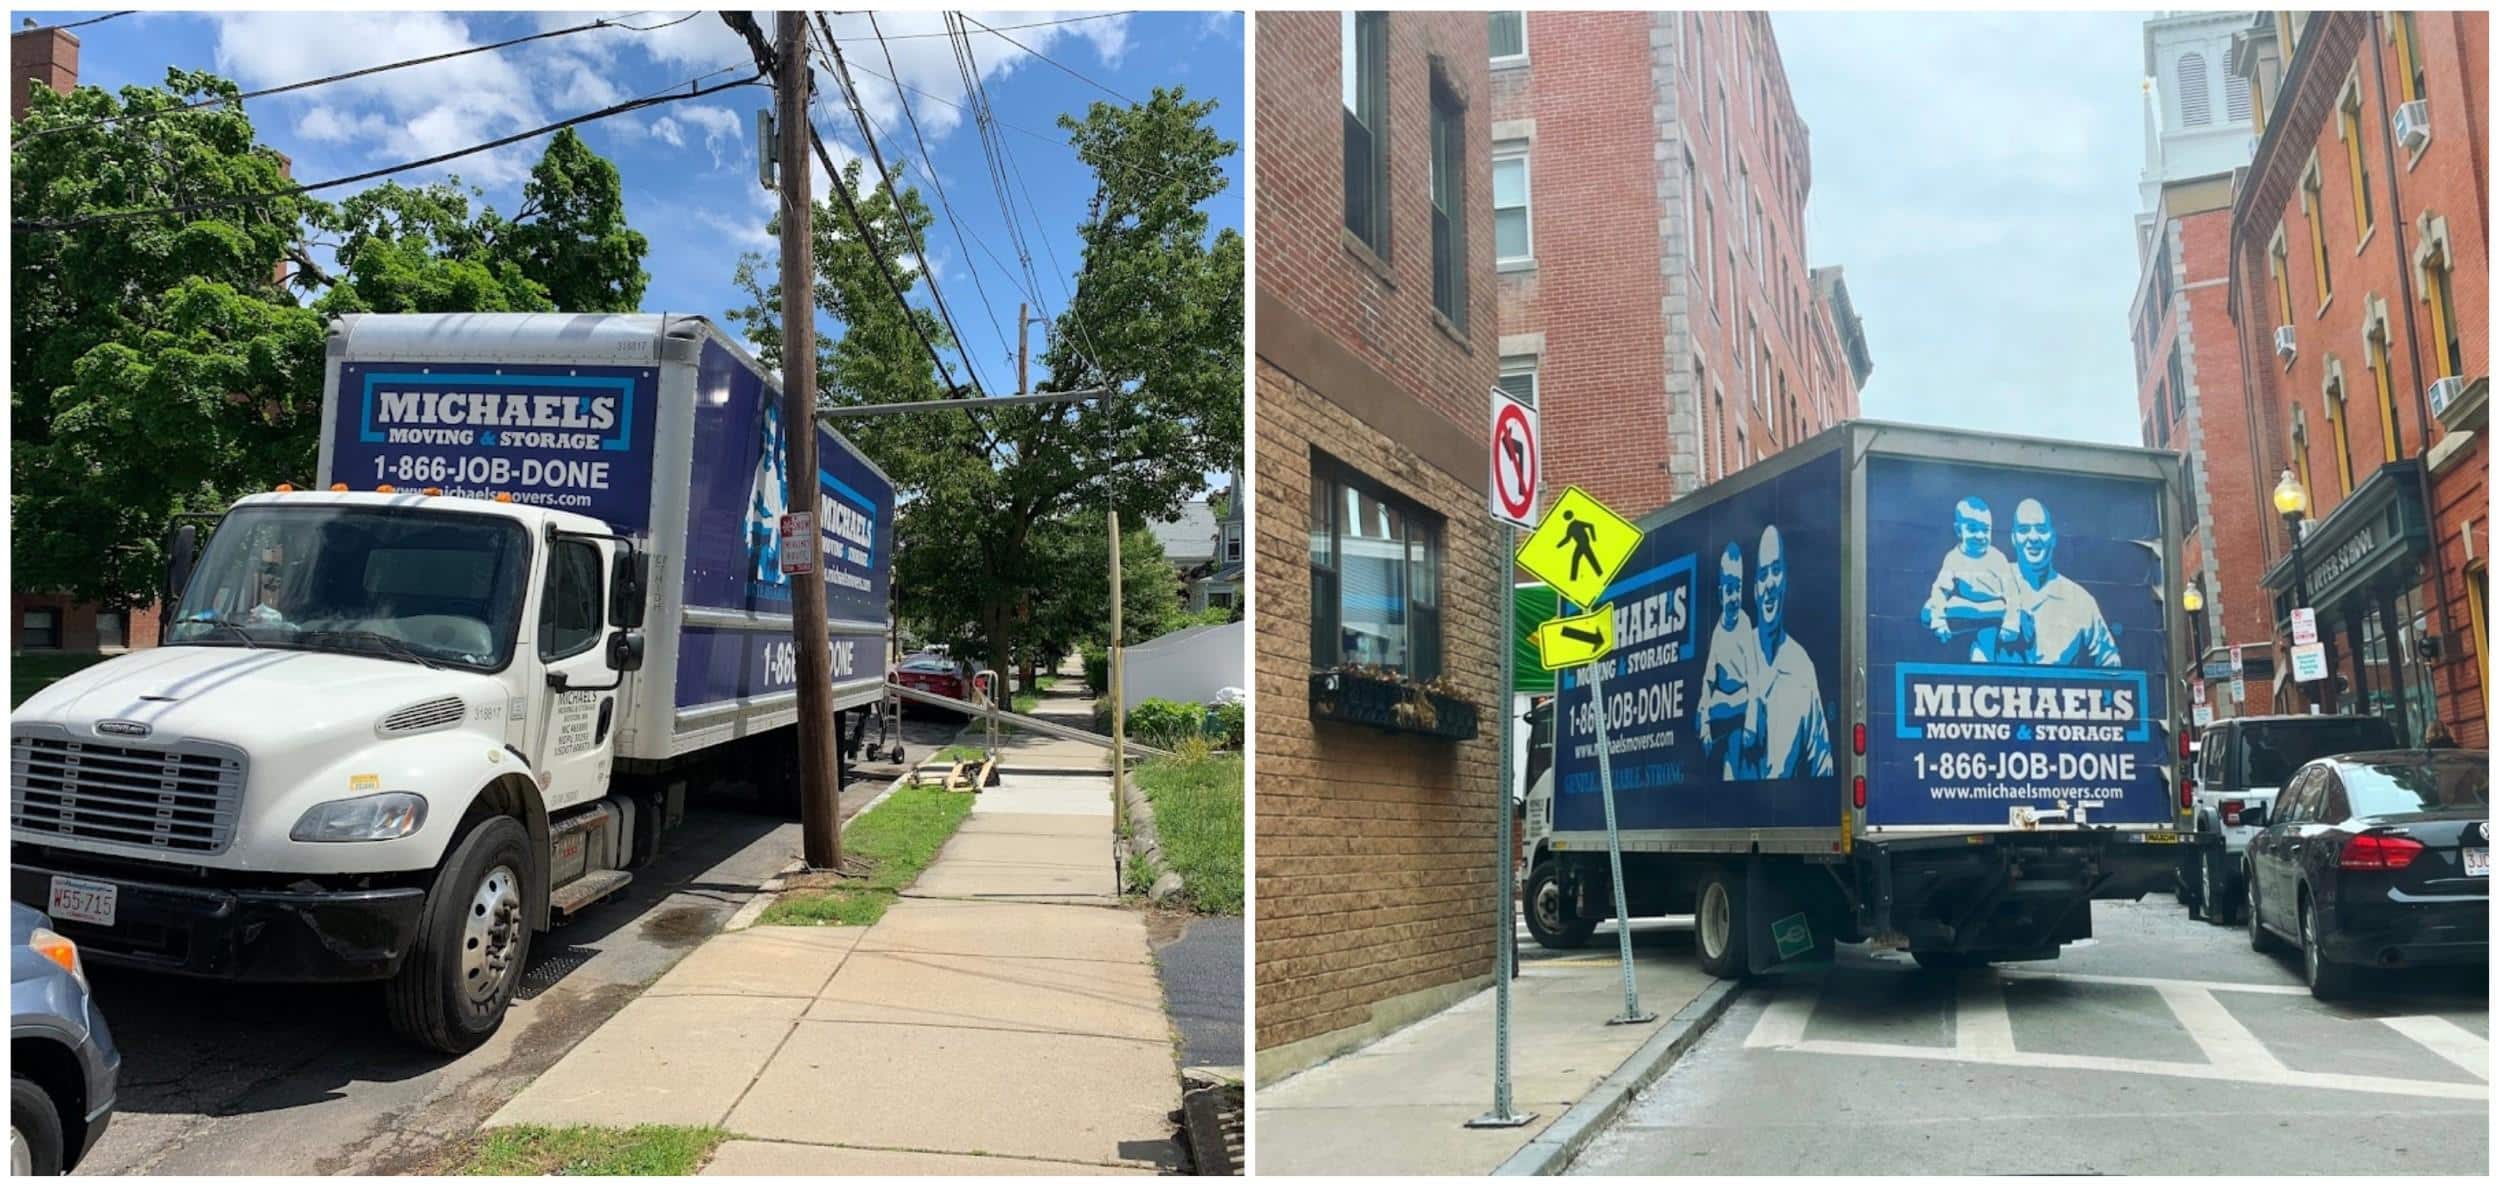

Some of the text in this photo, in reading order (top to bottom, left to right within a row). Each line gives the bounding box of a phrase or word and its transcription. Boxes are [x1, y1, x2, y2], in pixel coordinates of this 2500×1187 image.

[378, 392, 615, 429] MICHAEL'S
[388, 428, 600, 450] MOVING & STORAGE
[374, 454, 610, 489] 1-866-JOB-DONE
[1613, 585, 1687, 650] HAEL'S
[1576, 659, 1616, 687] MOING
[1627, 641, 1680, 675] STORAGE
[1569, 680, 1684, 737] 1-86-JOB-DONE
[1913, 683, 2134, 720] MICHAEL'S
[1926, 722, 2124, 742] MOVING & STORAGE
[1913, 751, 2136, 781] 1-866-JOB-DONE
[1930, 783, 2123, 800] www.michaelsmovers.com
